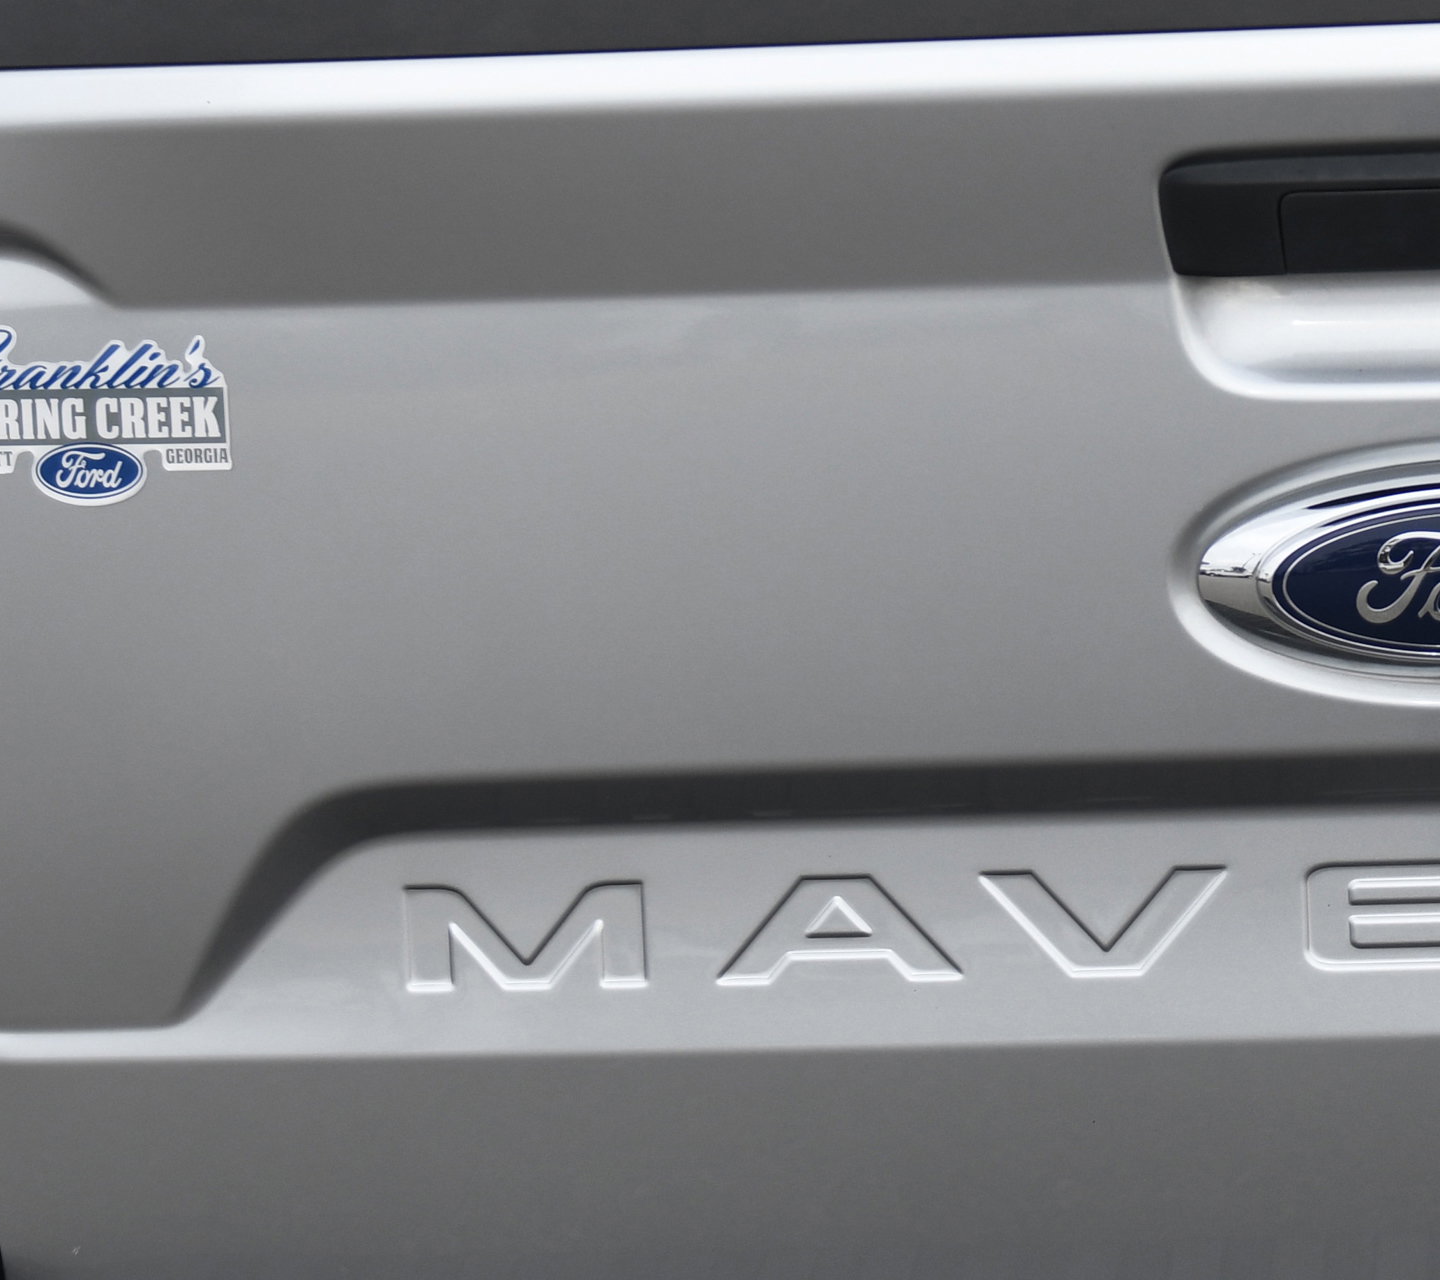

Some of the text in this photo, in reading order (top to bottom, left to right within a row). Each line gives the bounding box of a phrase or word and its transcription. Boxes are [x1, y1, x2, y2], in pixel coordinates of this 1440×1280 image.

[95, 395, 222, 440] CREEK
[55, 449, 123, 490] Ford
[165, 447, 229, 465] GEORGIA
